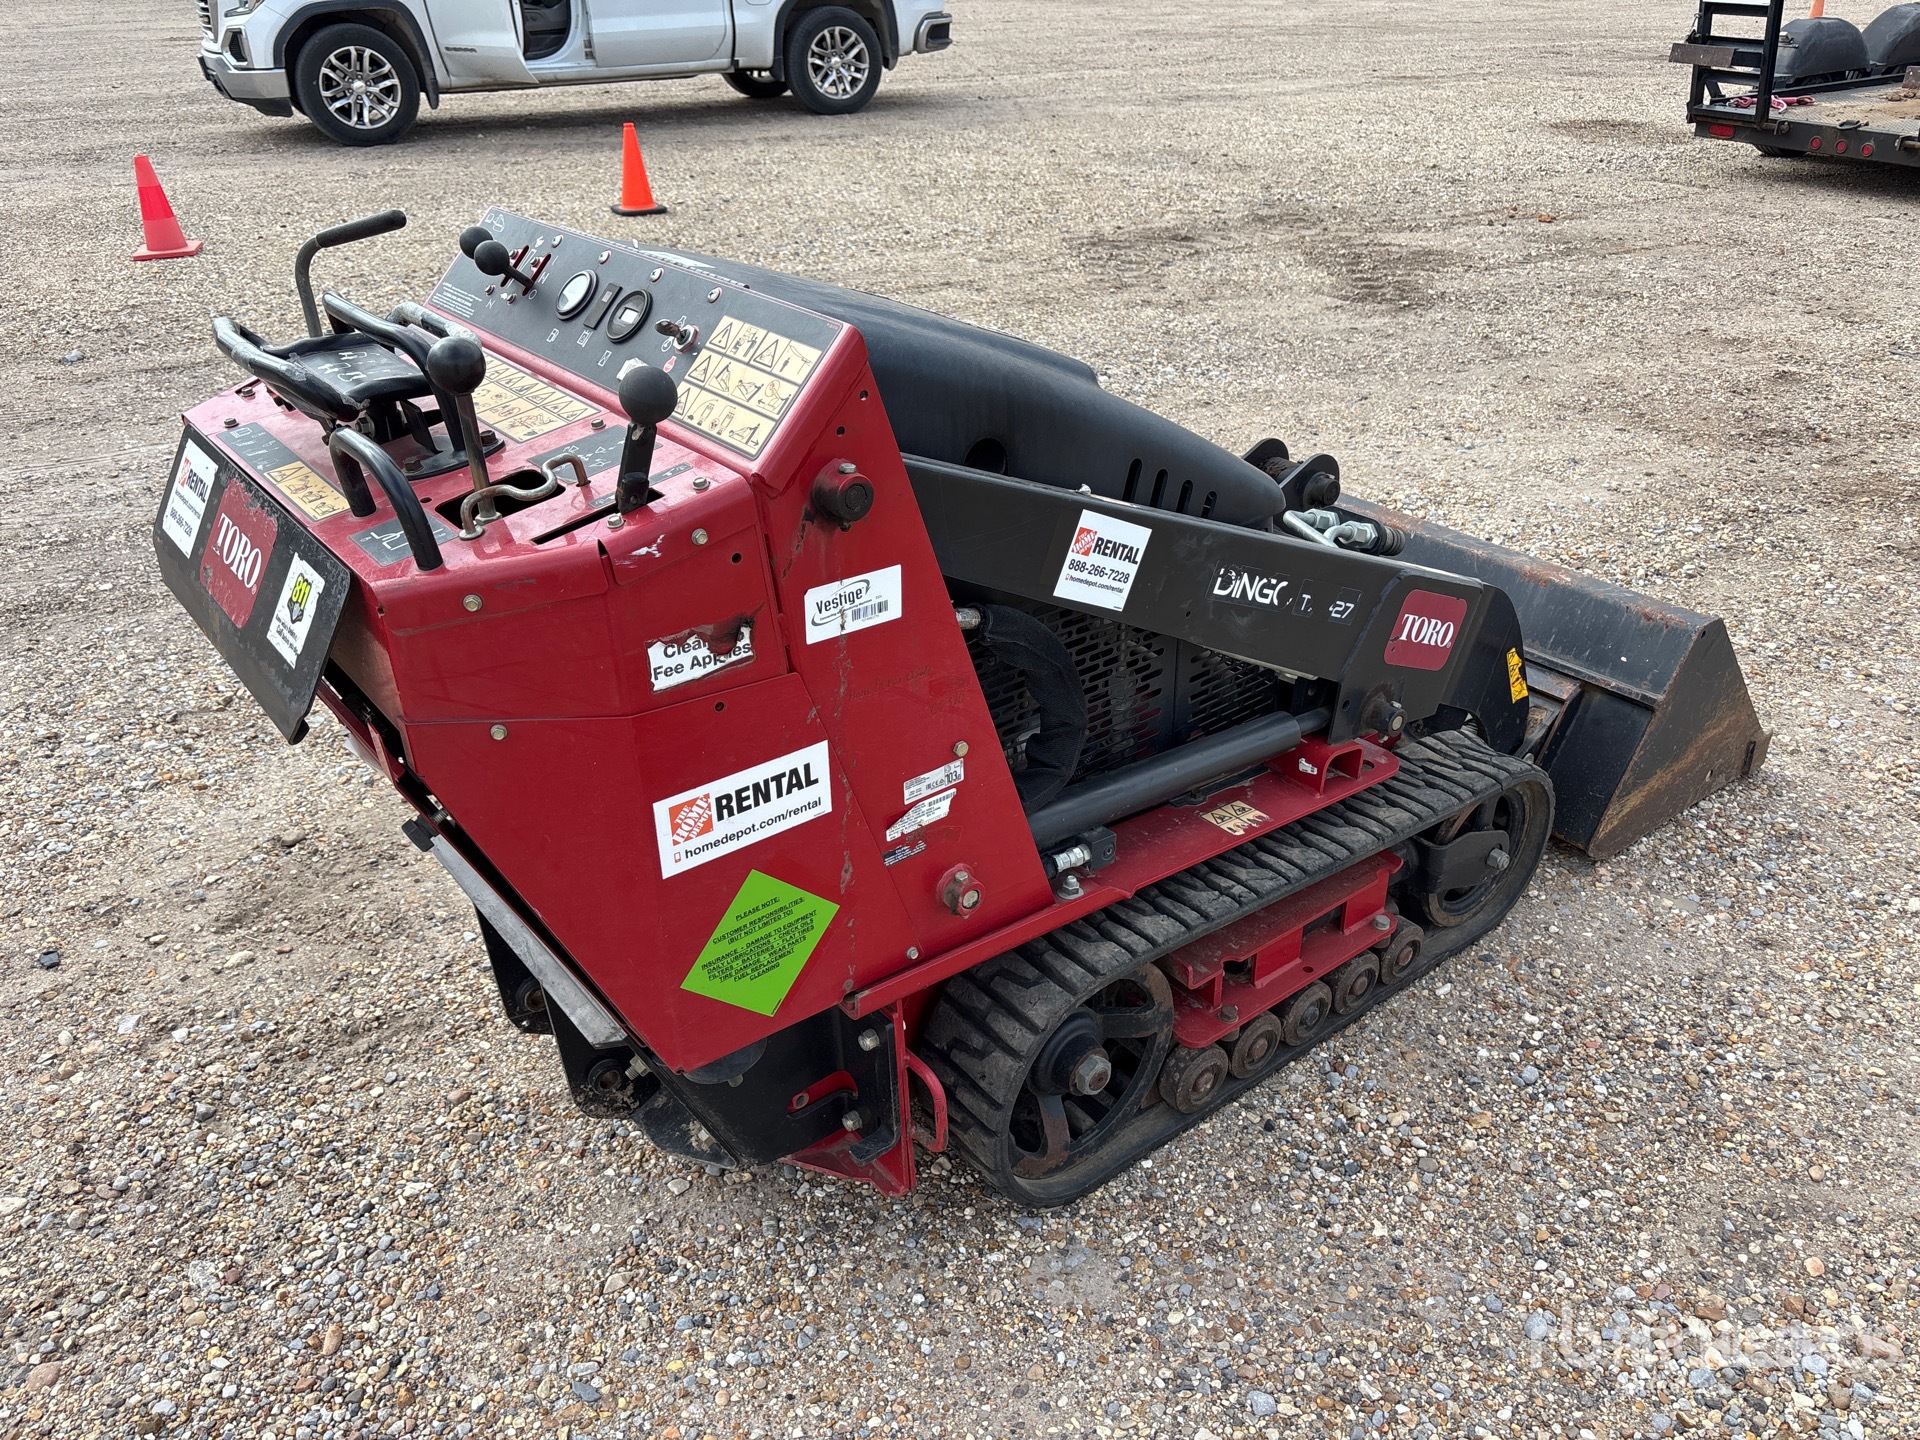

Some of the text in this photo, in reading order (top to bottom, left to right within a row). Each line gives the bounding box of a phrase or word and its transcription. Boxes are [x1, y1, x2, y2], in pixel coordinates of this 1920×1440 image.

[186, 468, 209, 504] RENTAL
[215, 512, 262, 588] TORO
[1072, 530, 1097, 553] HOME
[1092, 536, 1140, 565] RENTAL
[1068, 559, 1130, 584] 888-266-7228
[1069, 574, 1124, 594] homedepot.com/rental
[291, 574, 312, 611] 811
[816, 587, 862, 614] Vestige
[1399, 613, 1453, 648] TORO
[653, 663, 685, 681] Fee
[714, 762, 819, 822] RENTAL
[672, 795, 712, 844] THE HOME DEPOT
[684, 797, 822, 859] homedepot.com/rental
[736, 897, 780, 921] PLEASE NOTE:
[702, 910, 817, 970] INSURANCE DAMAGE TO EQUIPMENT
[713, 924, 748, 944] CUSTOMER
[728, 909, 793, 945] (BUT NOT LIMITED TO)
[707, 919, 814, 974] DAILY LUBRICATIONS CHECK OILS
[709, 925, 814, 980] FILTERS BATTERIES FLAT TIRES
[719, 936, 806, 982] TIRE DAMAGE WEAR PARTS
[734, 949, 794, 982] FUEL REPLACEMENT
[750, 962, 780, 981] CLEANING
